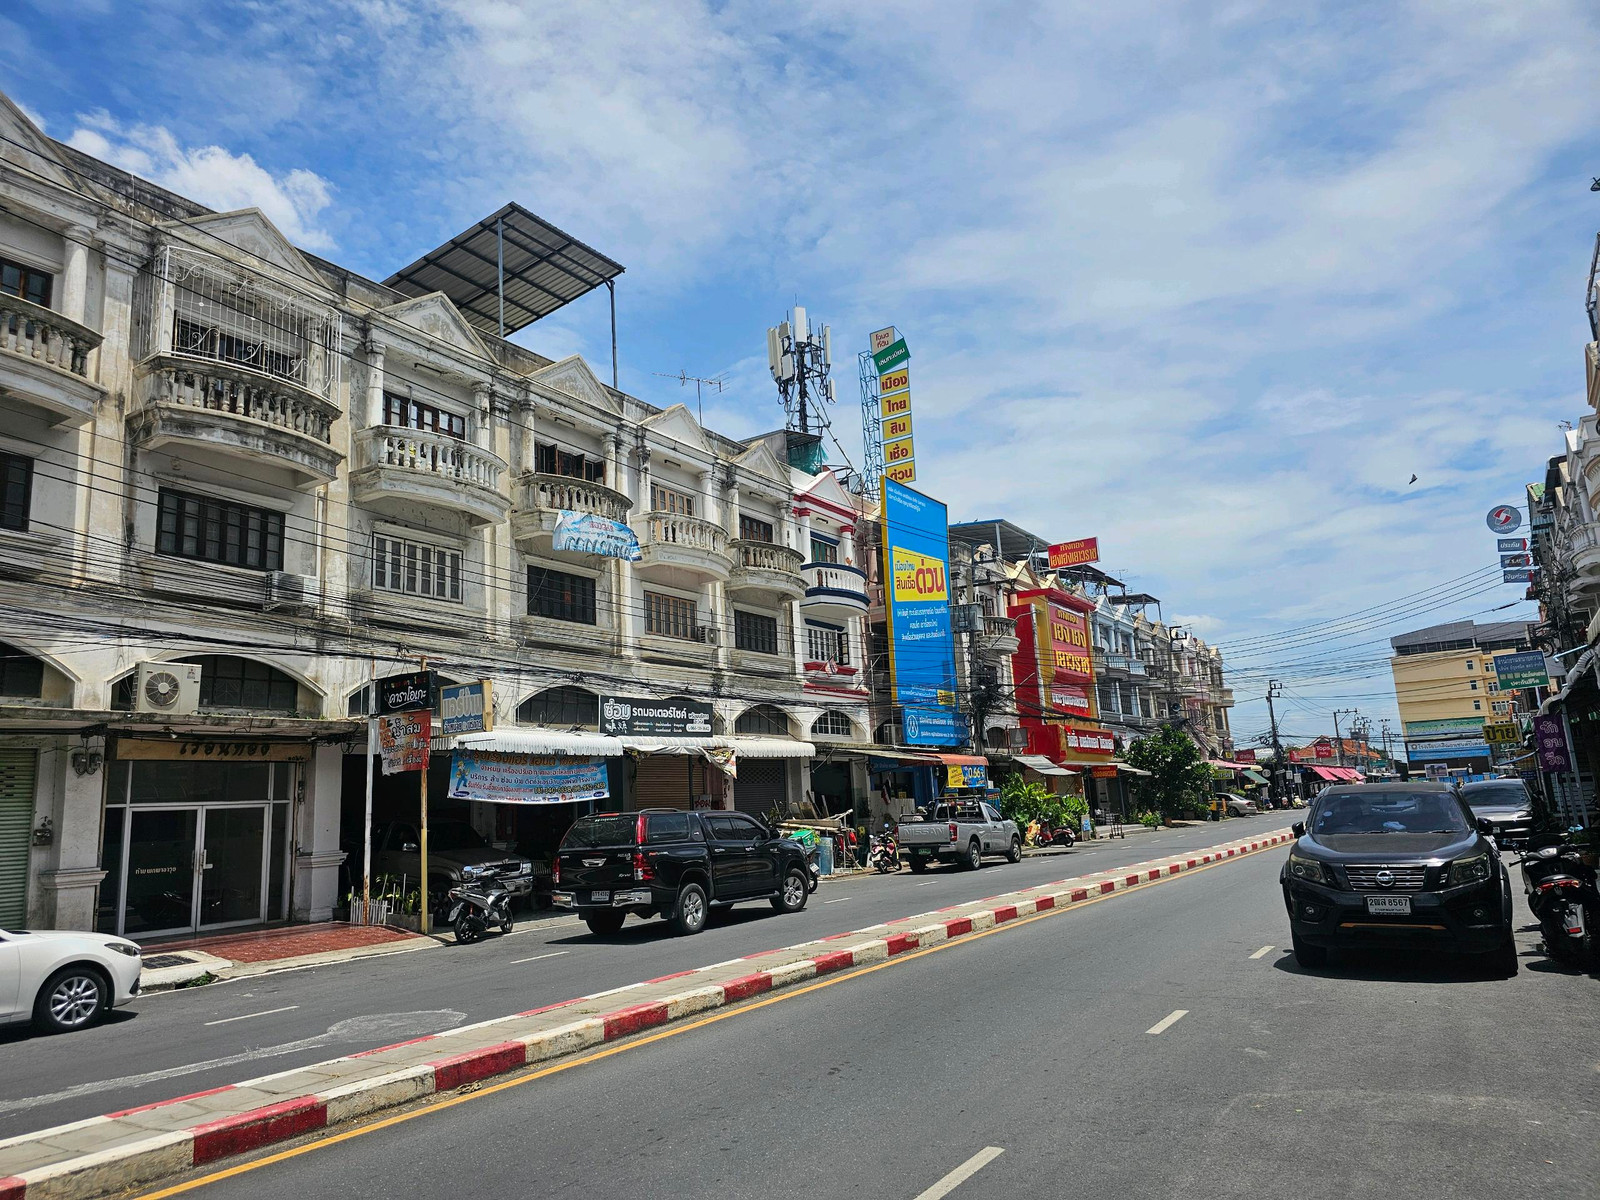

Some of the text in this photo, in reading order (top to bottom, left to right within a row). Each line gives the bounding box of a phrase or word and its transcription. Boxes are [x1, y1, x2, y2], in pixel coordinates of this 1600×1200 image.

[881, 375, 908, 391] เมือง
[886, 398, 907, 413] ไทย
[890, 421, 906, 435] สิน
[889, 444, 908, 460] เชื่อ
[895, 560, 915, 572] เมืองไทย
[896, 558, 945, 594] สินเชื่อ ด่วน
[1055, 650, 1091, 674] เยาวราช
[389, 686, 427, 704] คาราโอเกะ
[604, 698, 631, 720] ซ่อม
[1485, 725, 1516, 741] ป้าย
[1543, 737, 1564, 748] อบ
[470, 772, 488, 782] บริการ
[501, 775, 513, 784] ซ่อม
[903, 826, 945, 837] NISSAN
[1388, 898, 1408, 906] 8567
